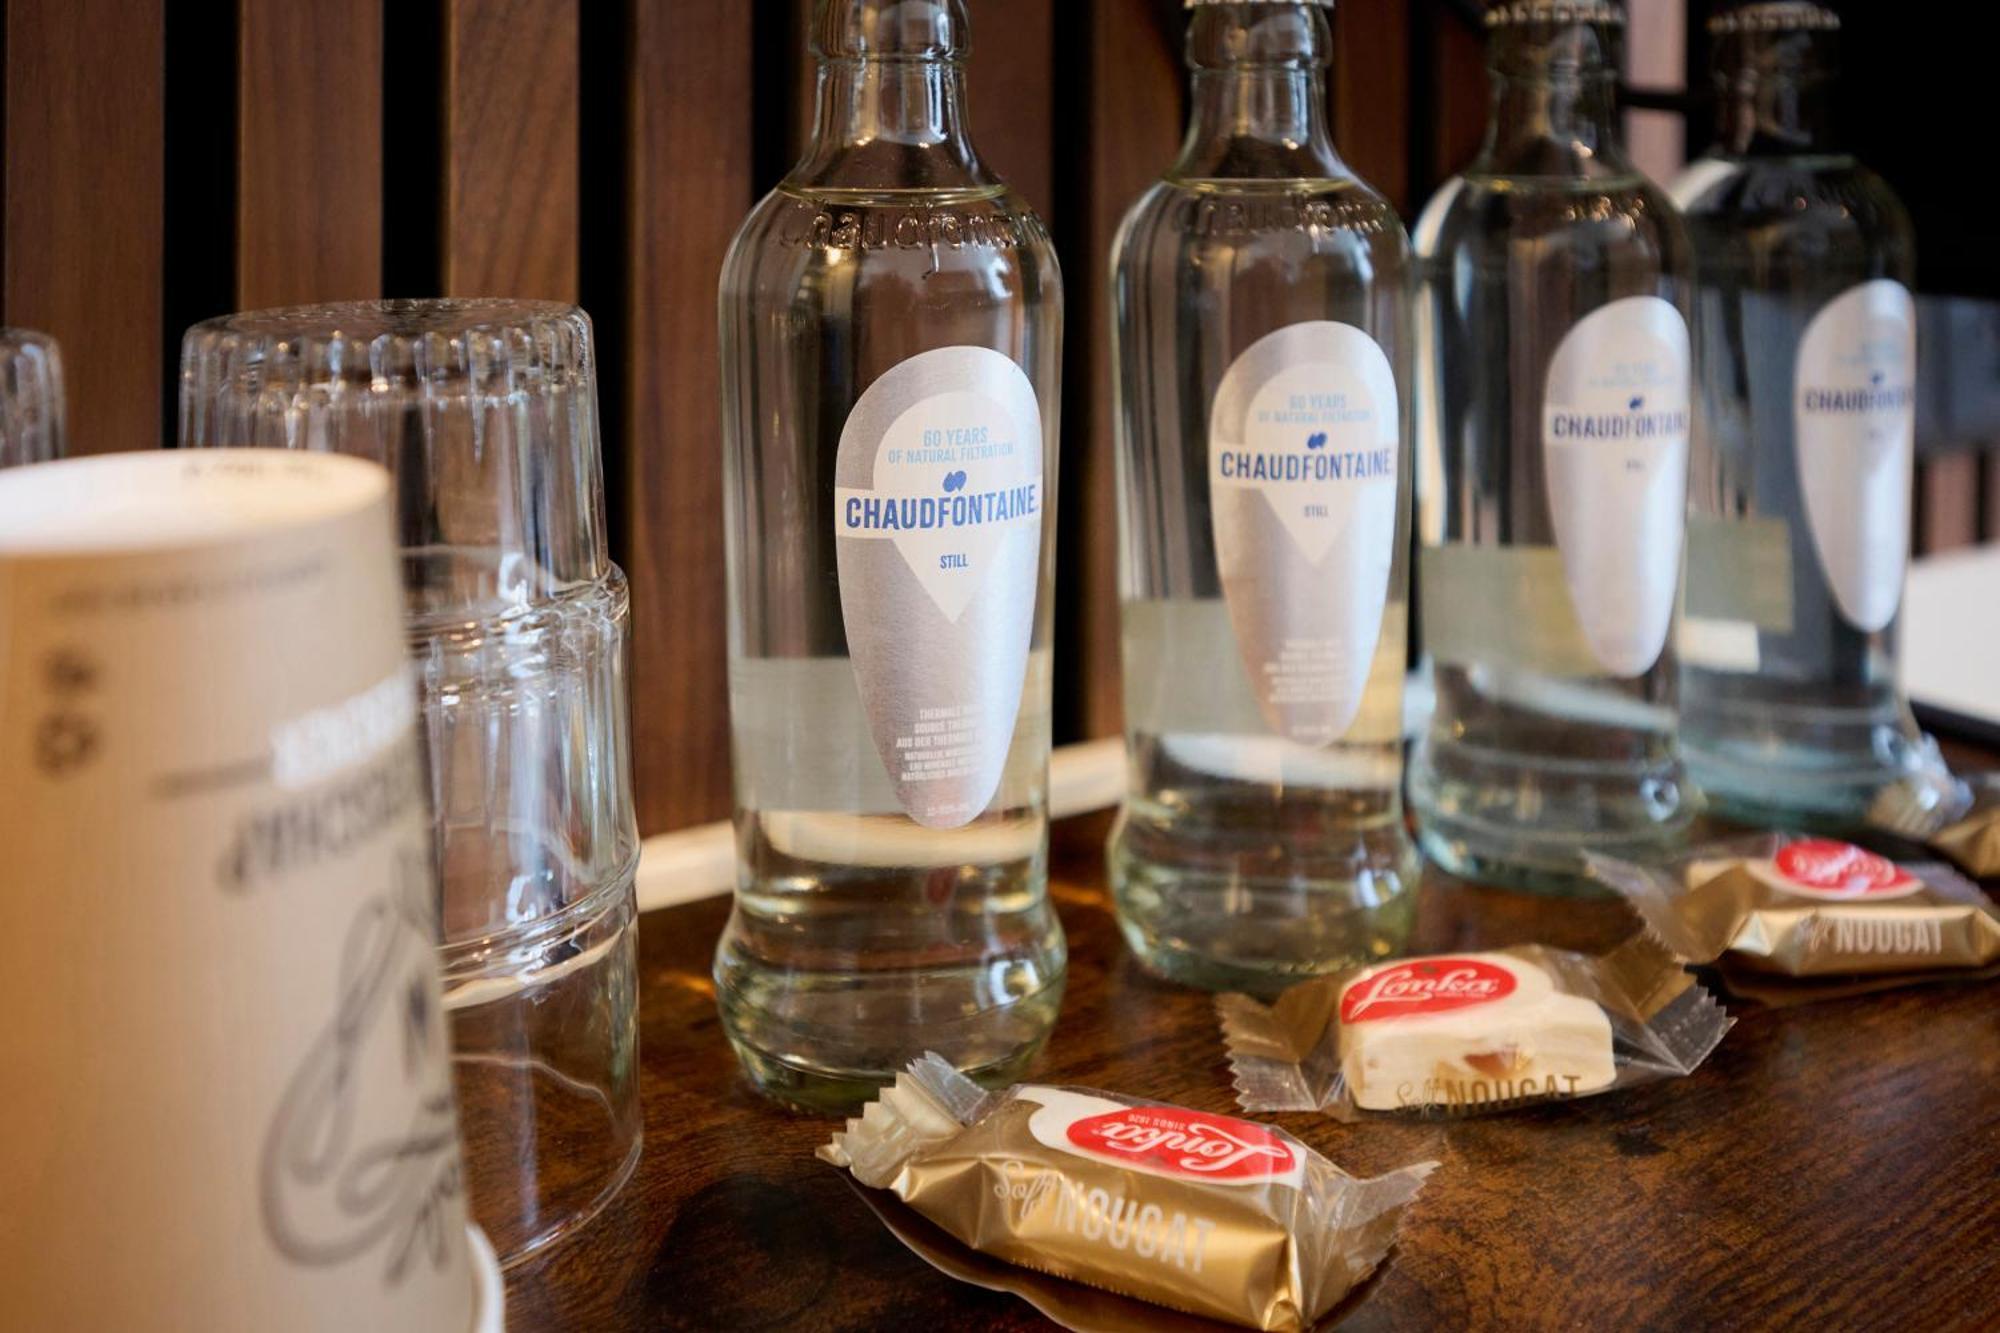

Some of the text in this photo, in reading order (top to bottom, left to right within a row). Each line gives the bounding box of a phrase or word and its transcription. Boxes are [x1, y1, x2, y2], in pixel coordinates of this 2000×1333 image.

[888, 443, 1014, 464] OF NATURAL FILTRATION
[923, 426, 989, 448] 60 YEARS
[1220, 449, 1392, 482] CHAUDFONTAINE
[845, 485, 1036, 530] CHAUDFONTAINE
[939, 553, 969, 570] STILL
[1835, 918, 1942, 954] NOUGAT
[1348, 967, 1500, 1020] Lonka
[1100, 1120, 1290, 1172] Lonka
[1054, 1182, 1216, 1272] NOUGAT
